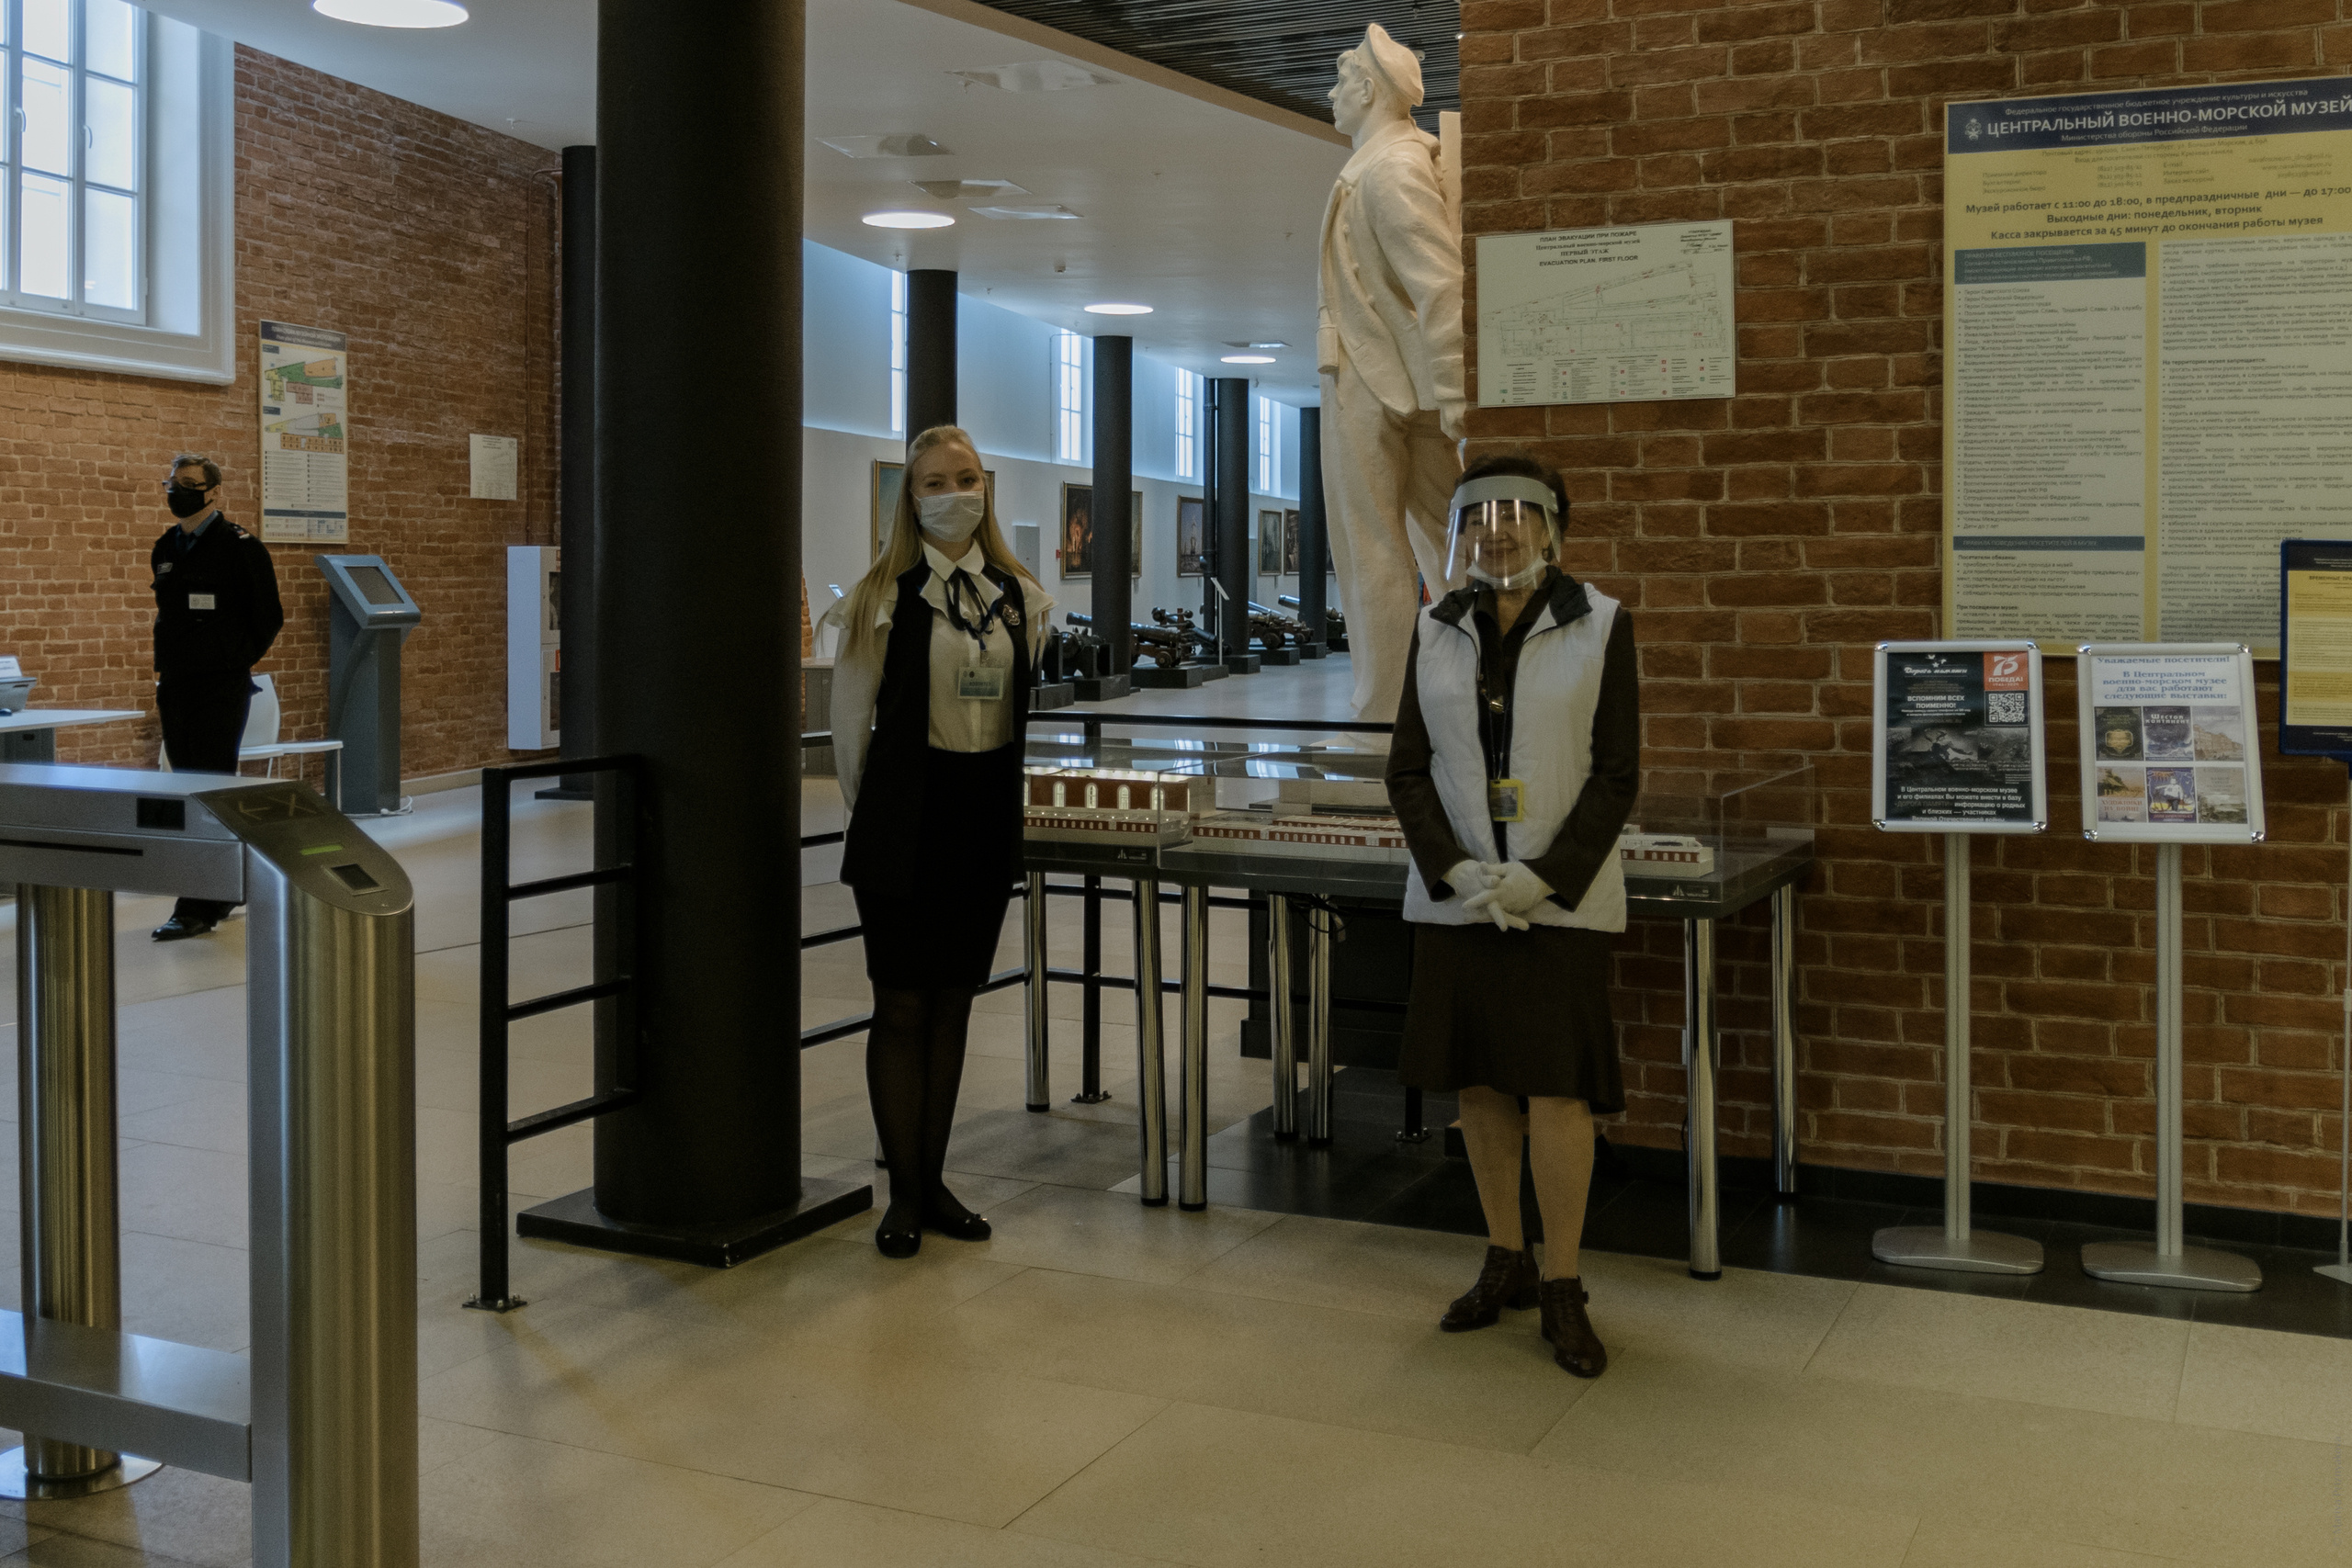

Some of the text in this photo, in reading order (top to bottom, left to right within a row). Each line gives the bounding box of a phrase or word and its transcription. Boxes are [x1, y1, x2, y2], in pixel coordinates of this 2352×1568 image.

[1987, 96, 2352, 137] ЦЕНТРАЛЬНЫЙ ВОЕННО-МОРСКОЙ МУЗЕЙ
[1966, 203, 2000, 215] Музей
[2003, 202, 2052, 213] работает
[2094, 200, 2107, 209] до
[2110, 197, 2143, 207] 18:00,
[2155, 192, 2259, 205] предпраздничные
[2266, 191, 2287, 199] дни
[2303, 189, 2318, 197] до
[2322, 187, 2352, 197] 17:00
[2047, 207, 2261, 223] Выходные дни: понедельник, вторник
[1991, 231, 2021, 240] Касса
[2024, 229, 2092, 239] закрывается
[2110, 228, 2122, 236] 45
[2125, 226, 2158, 234] минут
[2162, 225, 2176, 233] до
[2178, 222, 2240, 231] окончания
[2243, 219, 2285, 230] работы
[2289, 218, 2323, 227] музея
[1993, 655, 2018, 676] 75
[2133, 671, 2205, 679] Центральном
